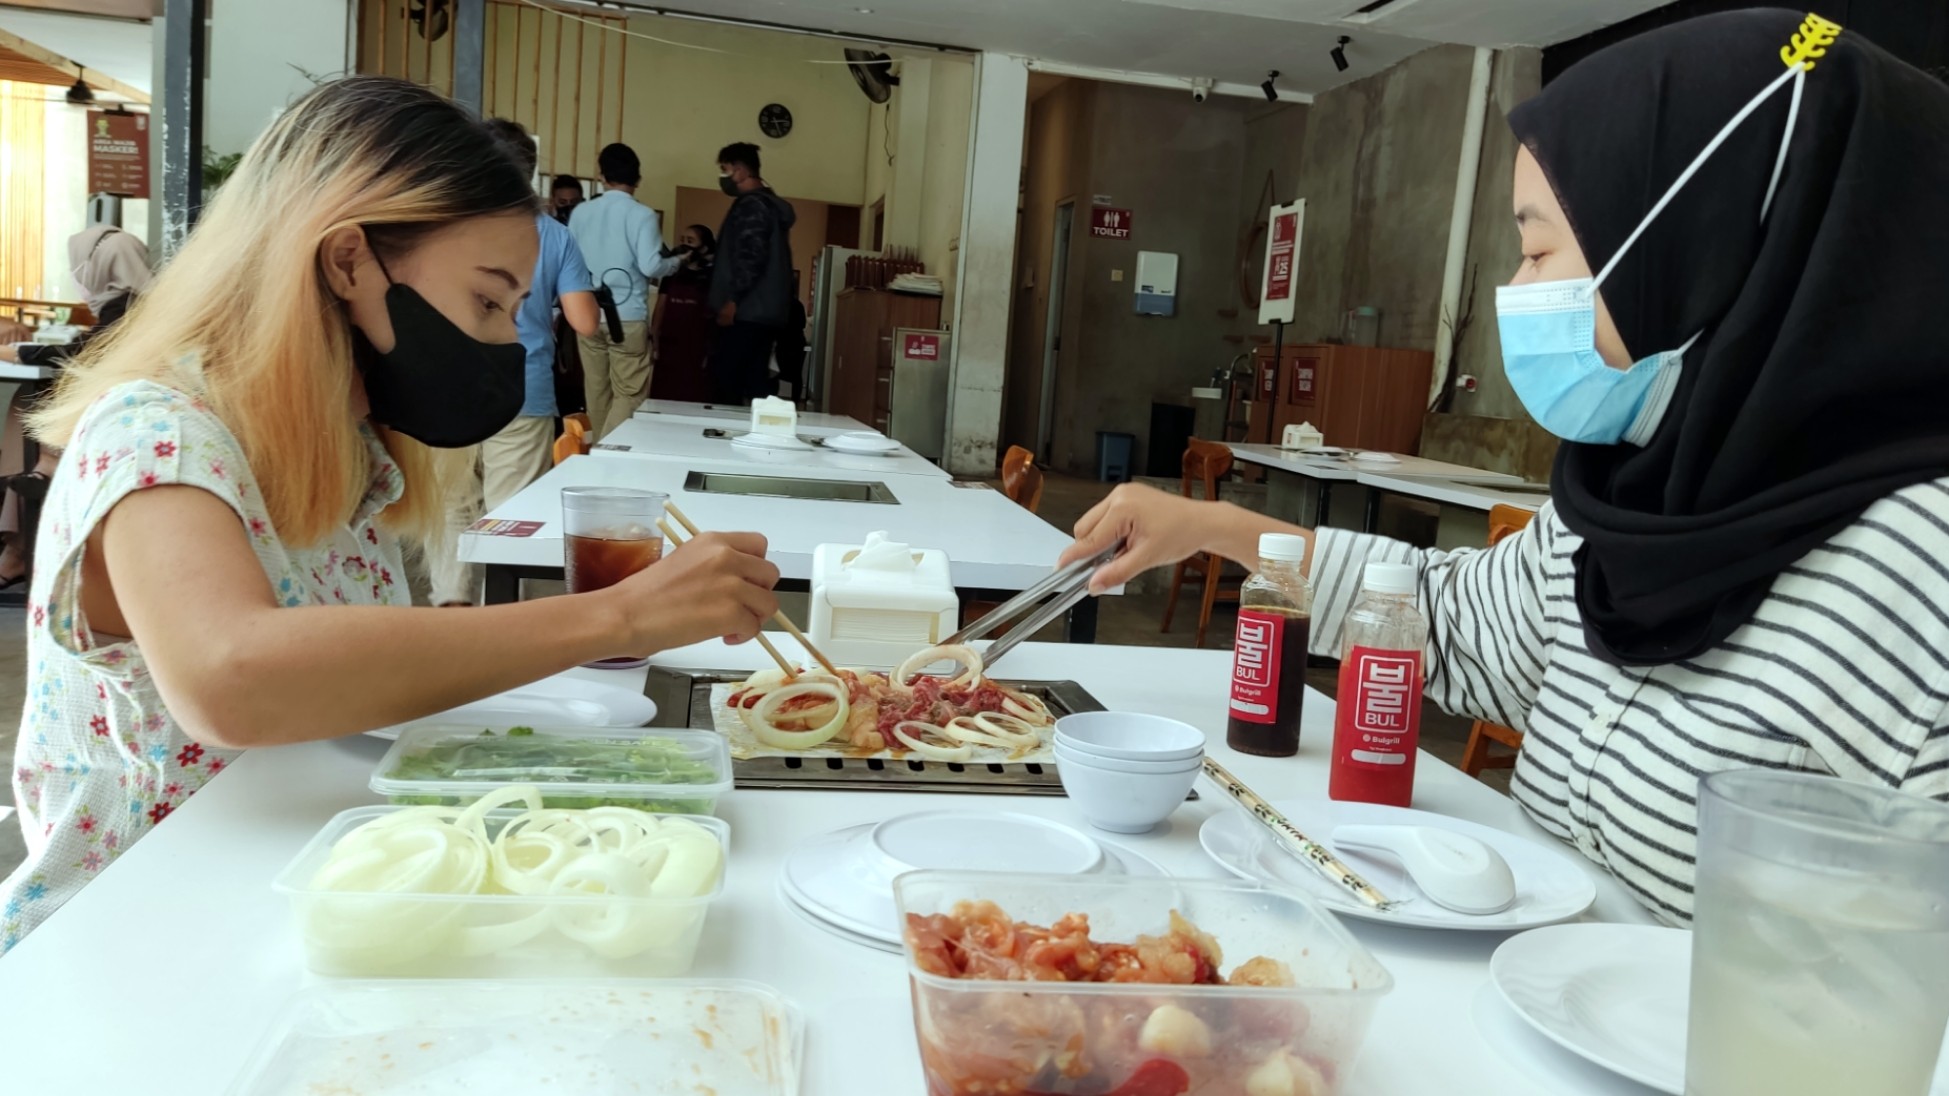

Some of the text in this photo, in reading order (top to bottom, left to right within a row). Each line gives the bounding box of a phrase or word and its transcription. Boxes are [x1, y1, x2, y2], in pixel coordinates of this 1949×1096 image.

[93, 145, 138, 154] MASKER!
[1093, 226, 1129, 237] TOILET
[1237, 623, 1268, 668] 불
[1236, 666, 1261, 680] BUL
[1239, 685, 1261, 696] Bulgrill
[1362, 662, 1409, 713] 불
[1365, 712, 1400, 727] BUL
[1372, 735, 1400, 745] Bulgrill
